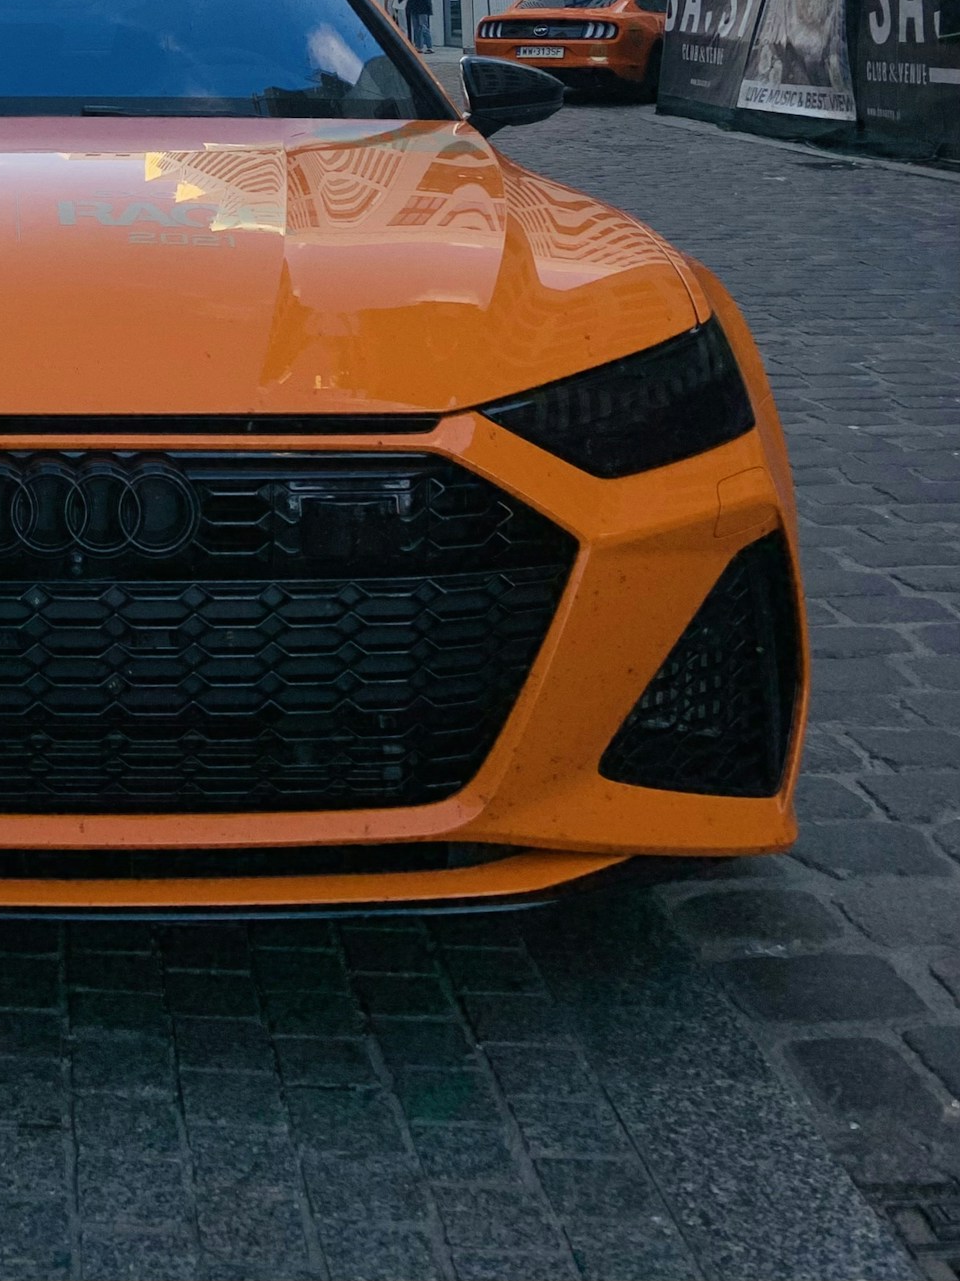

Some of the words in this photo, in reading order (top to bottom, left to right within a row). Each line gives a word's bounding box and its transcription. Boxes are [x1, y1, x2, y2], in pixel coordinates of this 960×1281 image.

[866, 60, 887, 82] CLUB
[898, 62, 928, 85] VENUE
[745, 86, 768, 104] LIVE
[766, 89, 797, 107] MUSIC
[804, 91, 829, 111] BEST
[828, 94, 853, 113] VIEW
[129, 232, 236, 248] 2021
